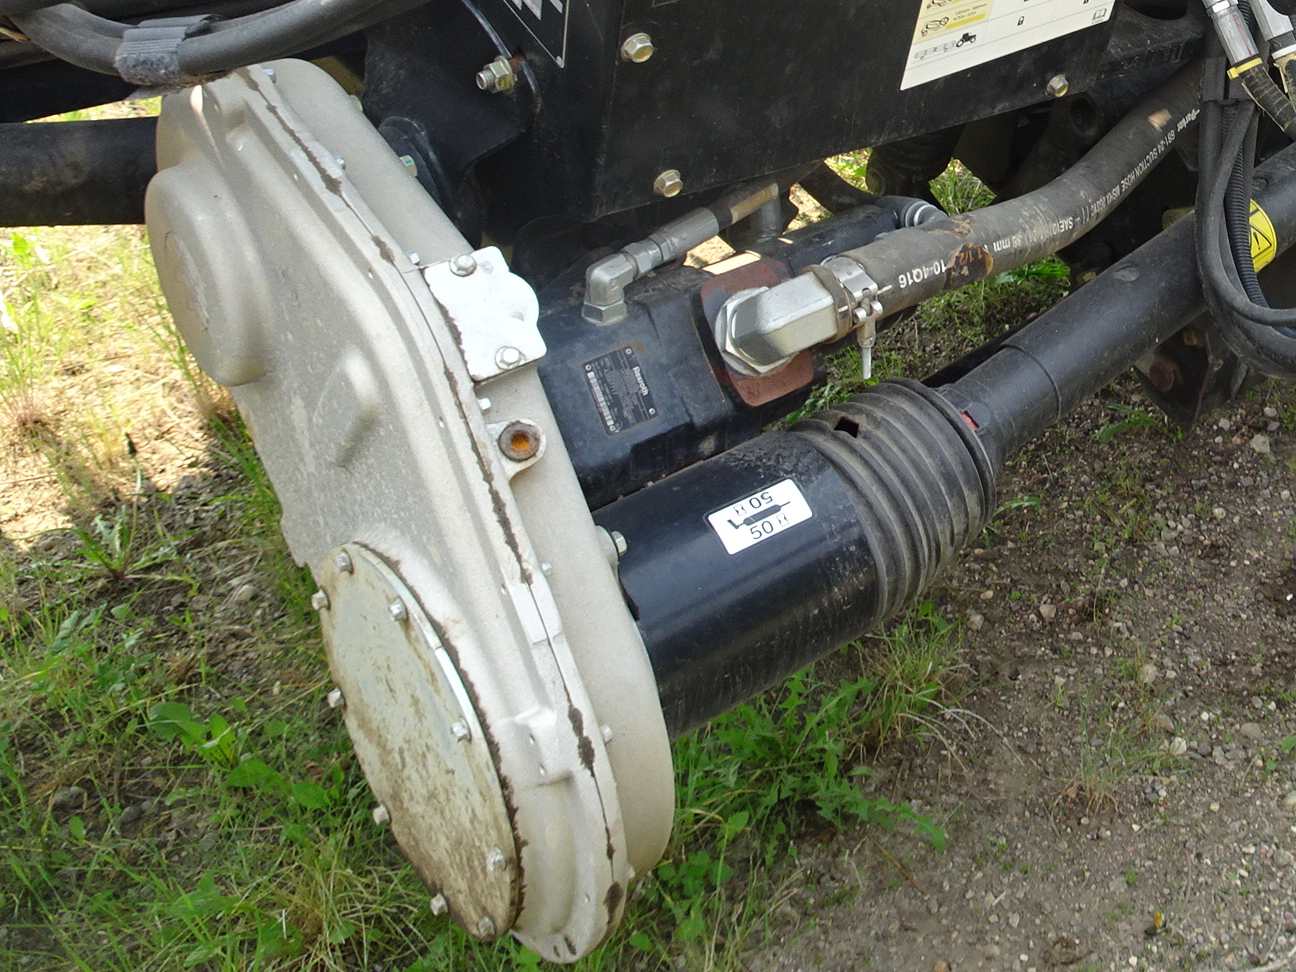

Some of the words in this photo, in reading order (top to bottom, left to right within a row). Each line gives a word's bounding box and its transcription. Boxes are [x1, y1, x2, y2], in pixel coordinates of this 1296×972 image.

[1177, 109, 1199, 132] Parker
[1134, 149, 1159, 176] SUCTION
[1120, 171, 1136, 192] HOSE
[993, 236, 1012, 252] mm
[898, 259, 947, 289] 10-4Q16
[632, 366, 649, 397] Rexroth
[749, 492, 773, 509] 50
[750, 521, 774, 540] 50
